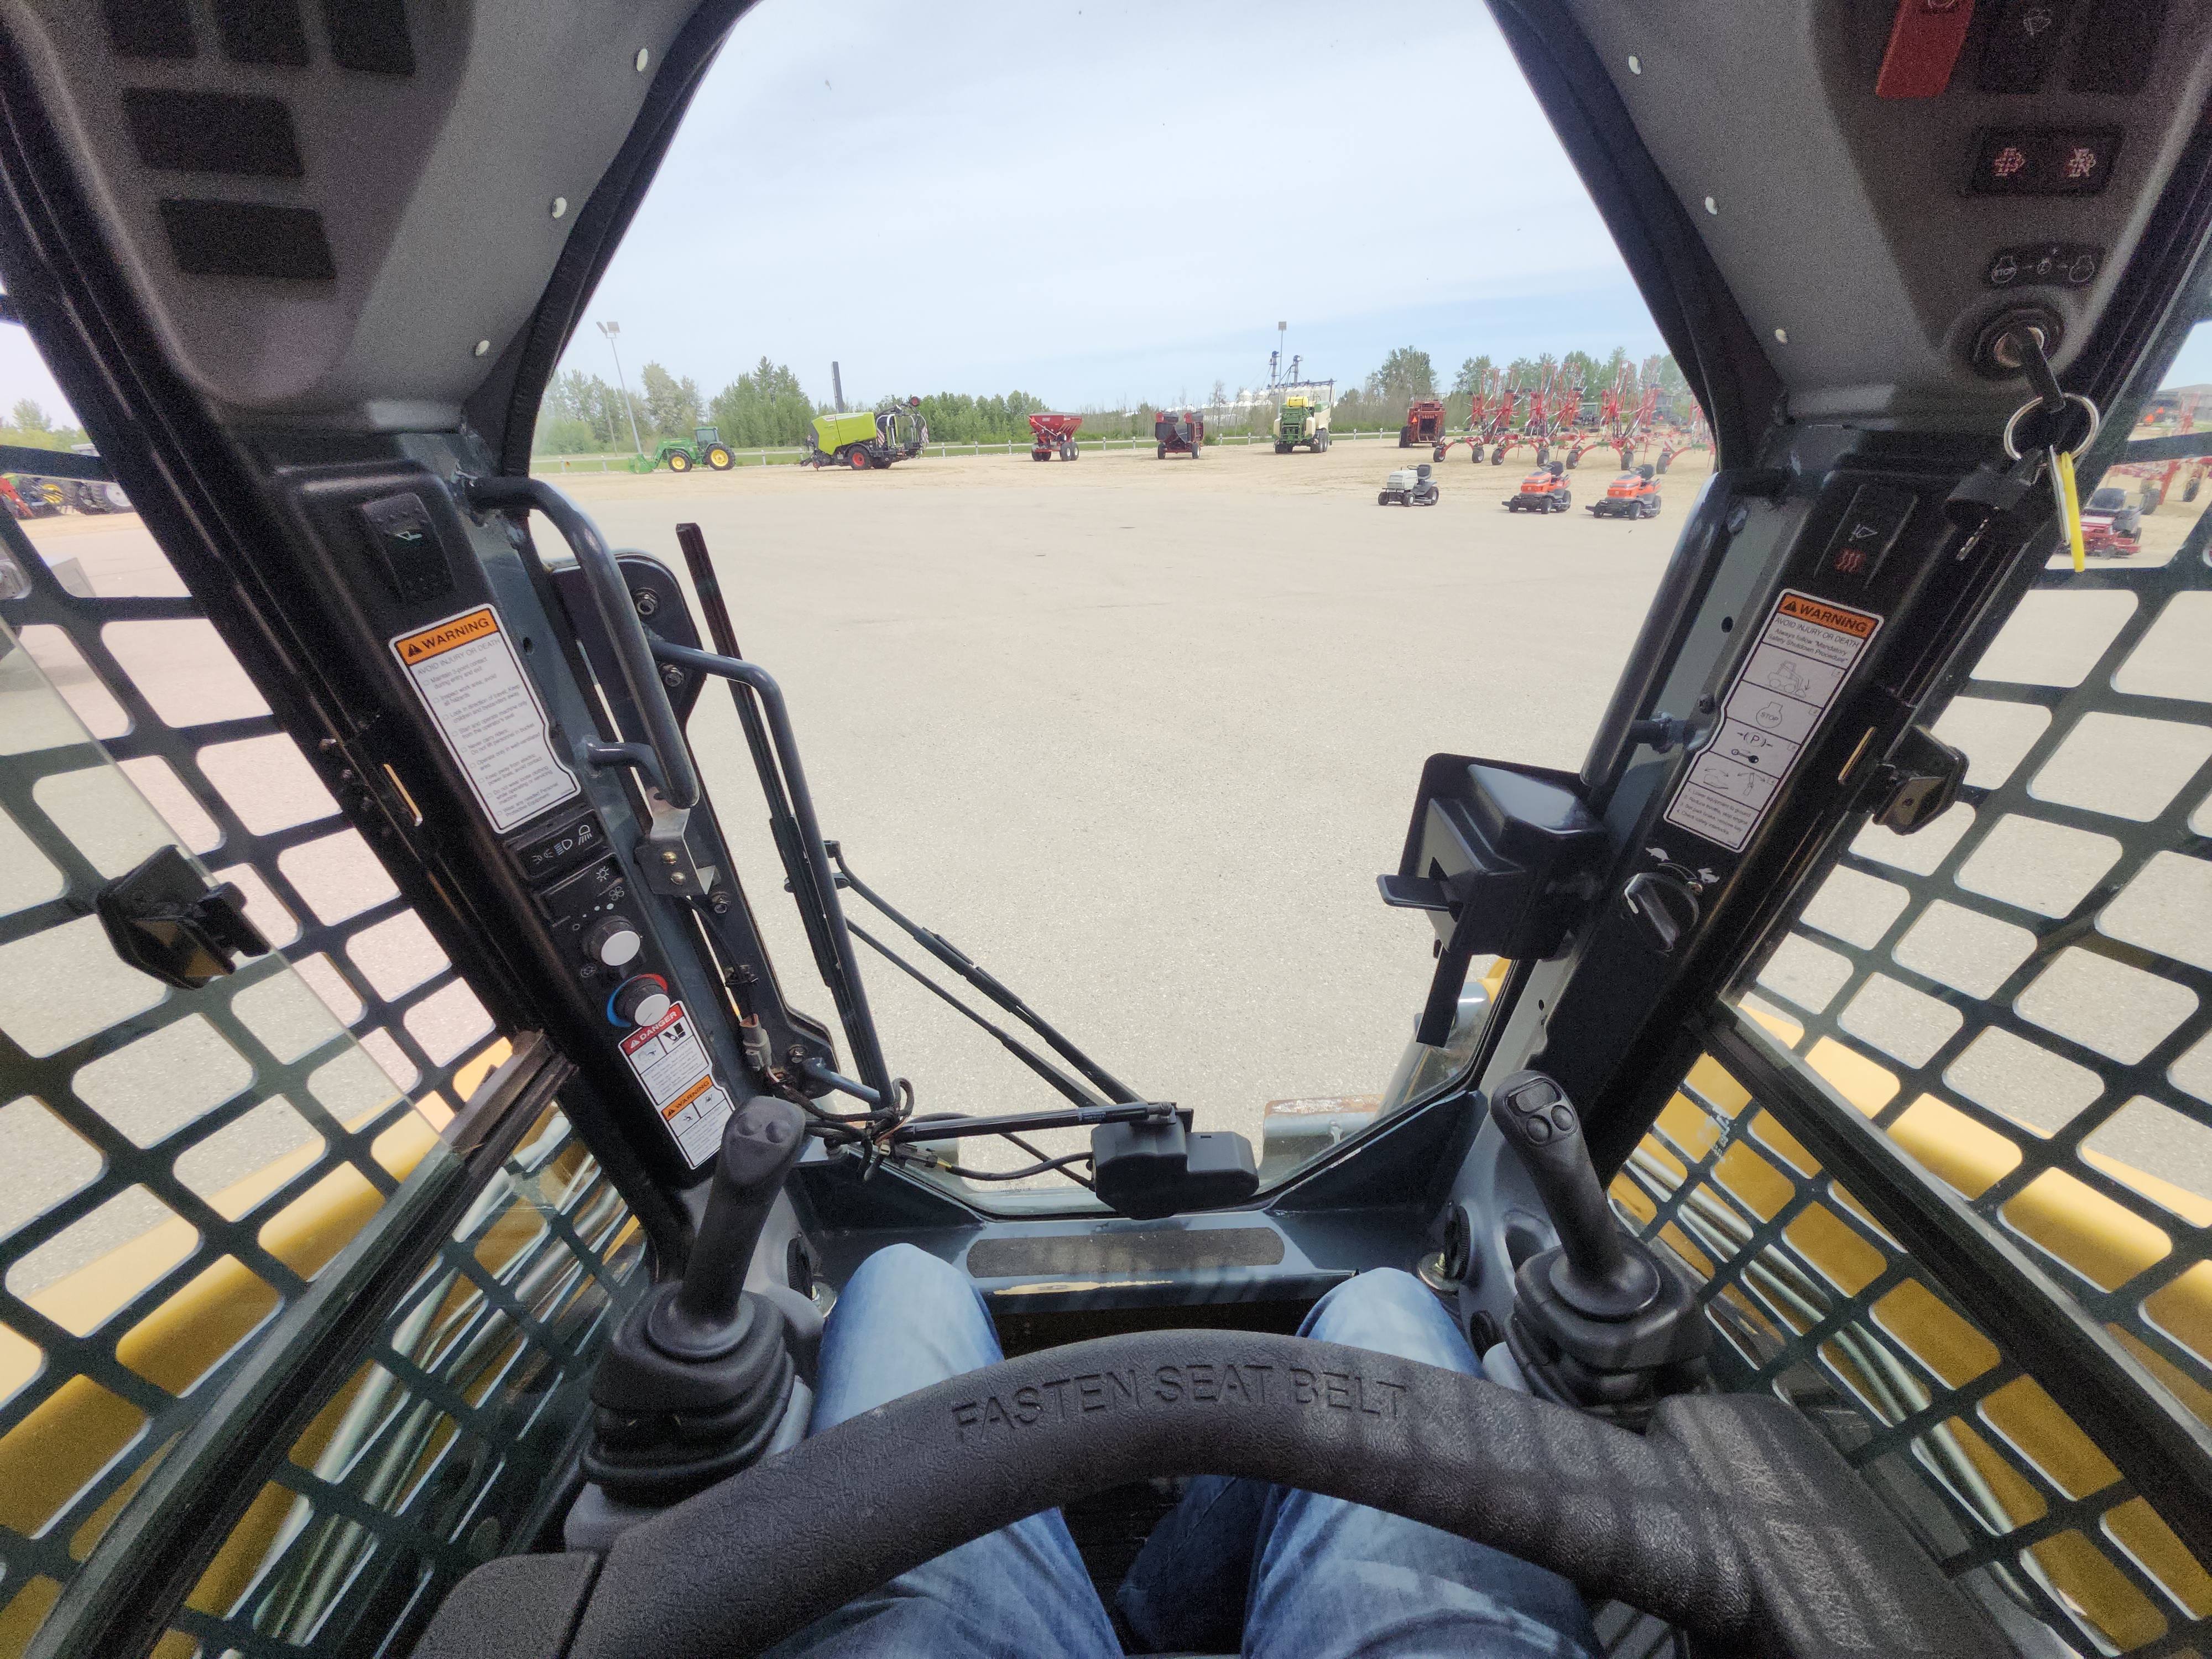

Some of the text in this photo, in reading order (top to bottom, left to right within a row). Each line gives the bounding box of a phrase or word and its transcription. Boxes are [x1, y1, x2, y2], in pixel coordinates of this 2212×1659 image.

[1774, 616, 1860, 648] AVOID INJURY OR DEATH
[1797, 603, 1869, 633] WARNING
[420, 616, 490, 650] WARNING
[415, 638, 501, 676] AVOID INJURY OR DEATH
[468, 656, 488, 667] contact
[470, 720, 481, 729] and
[471, 706, 482, 715] and
[1759, 711, 1779, 722] STOP
[1750, 735, 1760, 743] P
[639, 1010, 677, 1041] DANGER
[675, 1080, 709, 1108] WARNING
[951, 1363, 1406, 1437] FASTEN SEAT BELT
